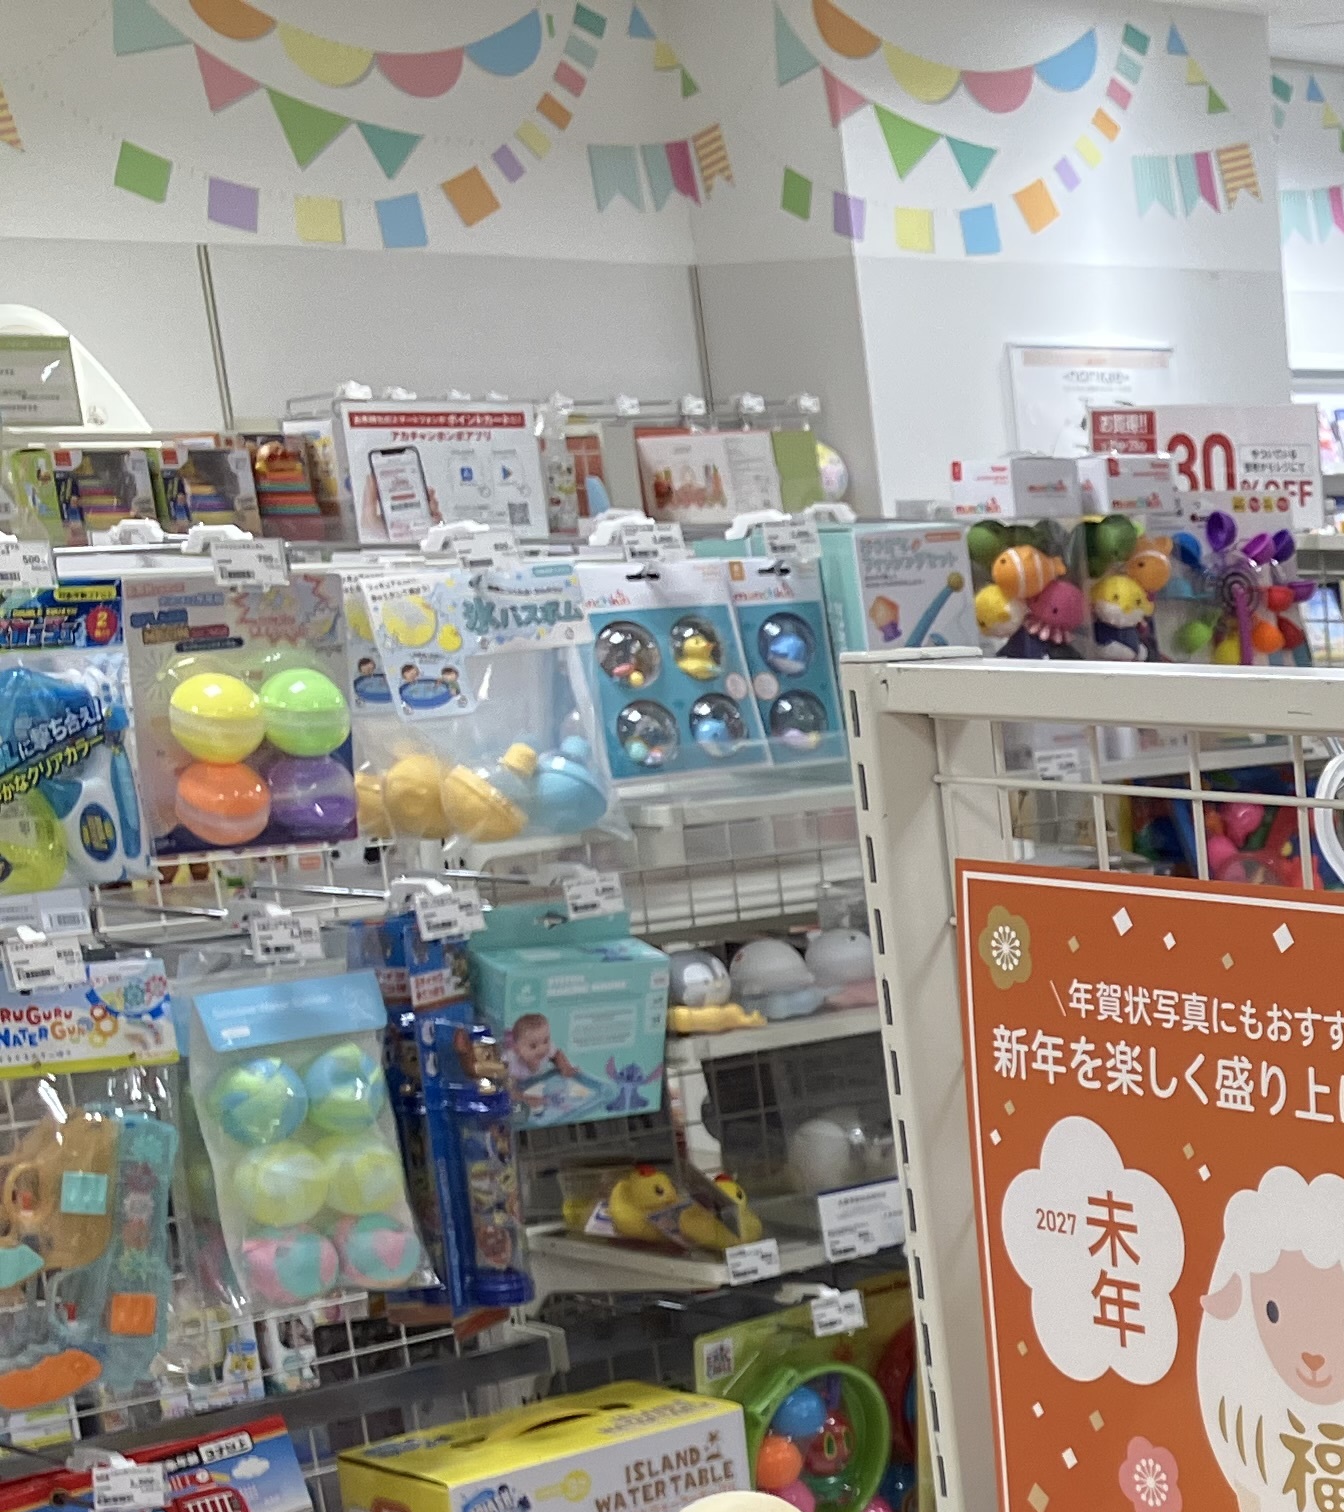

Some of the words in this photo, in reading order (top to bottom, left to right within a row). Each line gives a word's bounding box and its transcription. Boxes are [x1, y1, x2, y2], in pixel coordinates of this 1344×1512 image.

[1036, 1208, 1077, 1236] 2027
[1085, 1190, 1146, 1348] 未年
[625, 1446, 701, 1484] ISLAND
[670, 1460, 735, 1492] TABLE
